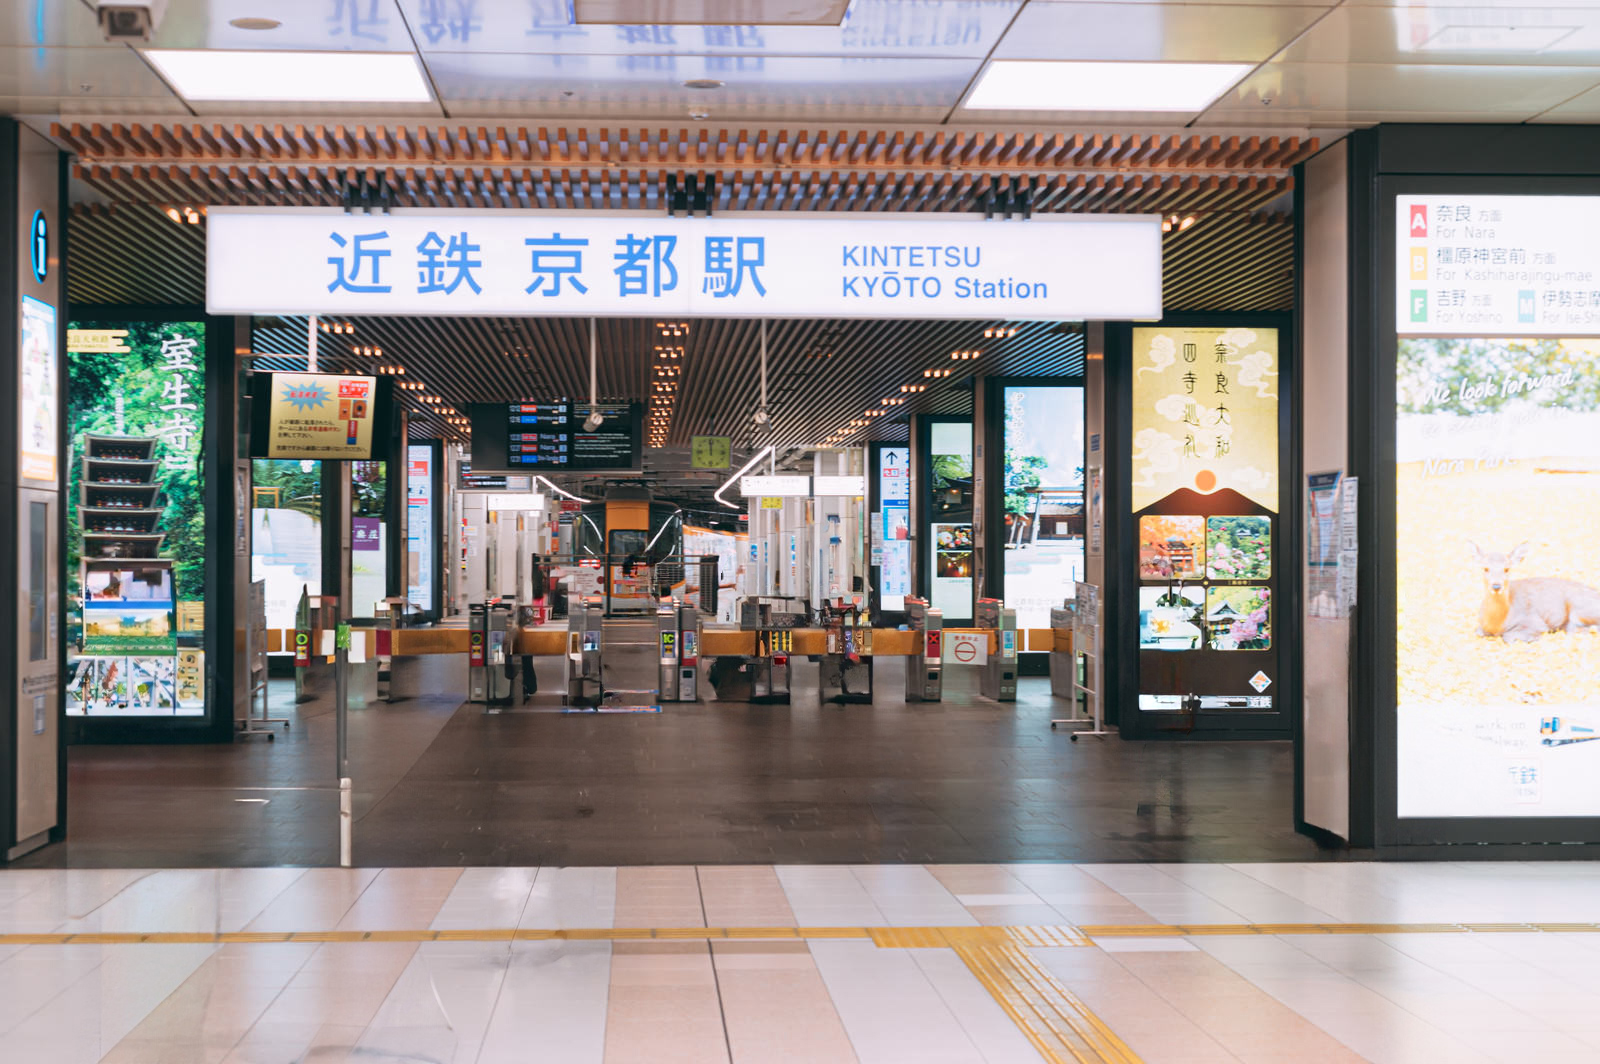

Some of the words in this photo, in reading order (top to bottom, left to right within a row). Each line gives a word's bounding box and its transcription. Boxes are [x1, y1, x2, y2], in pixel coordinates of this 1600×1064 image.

[1411, 213, 1426, 230] A
[1436, 204, 1471, 223] 奈良
[1478, 209, 1502, 223] 方面
[1436, 225, 1456, 239] For
[1465, 225, 1496, 239] Nara
[326, 230, 483, 296] 近鉄
[524, 232, 767, 299] 京都駅
[842, 245, 982, 268] KINTETSU
[1413, 255, 1425, 272] B
[1436, 247, 1526, 265] 橿原神宮前
[1532, 252, 1557, 265] 方面
[842, 271, 942, 299] KYŌTO
[954, 276, 1049, 299] Station
[1436, 268, 1456, 281] For
[1465, 267, 1593, 285] Kashiharajingu-mae
[1413, 297, 1425, 315] F
[1436, 289, 1467, 307] 吉野
[158, 333, 199, 452] 室生寺
[1424, 381, 1451, 405] We
[1459, 375, 1498, 402] look
[1501, 367, 1575, 398] forward
[1182, 343, 1201, 459] 四寺巡礼
[1214, 340, 1231, 459] 奈良大和
